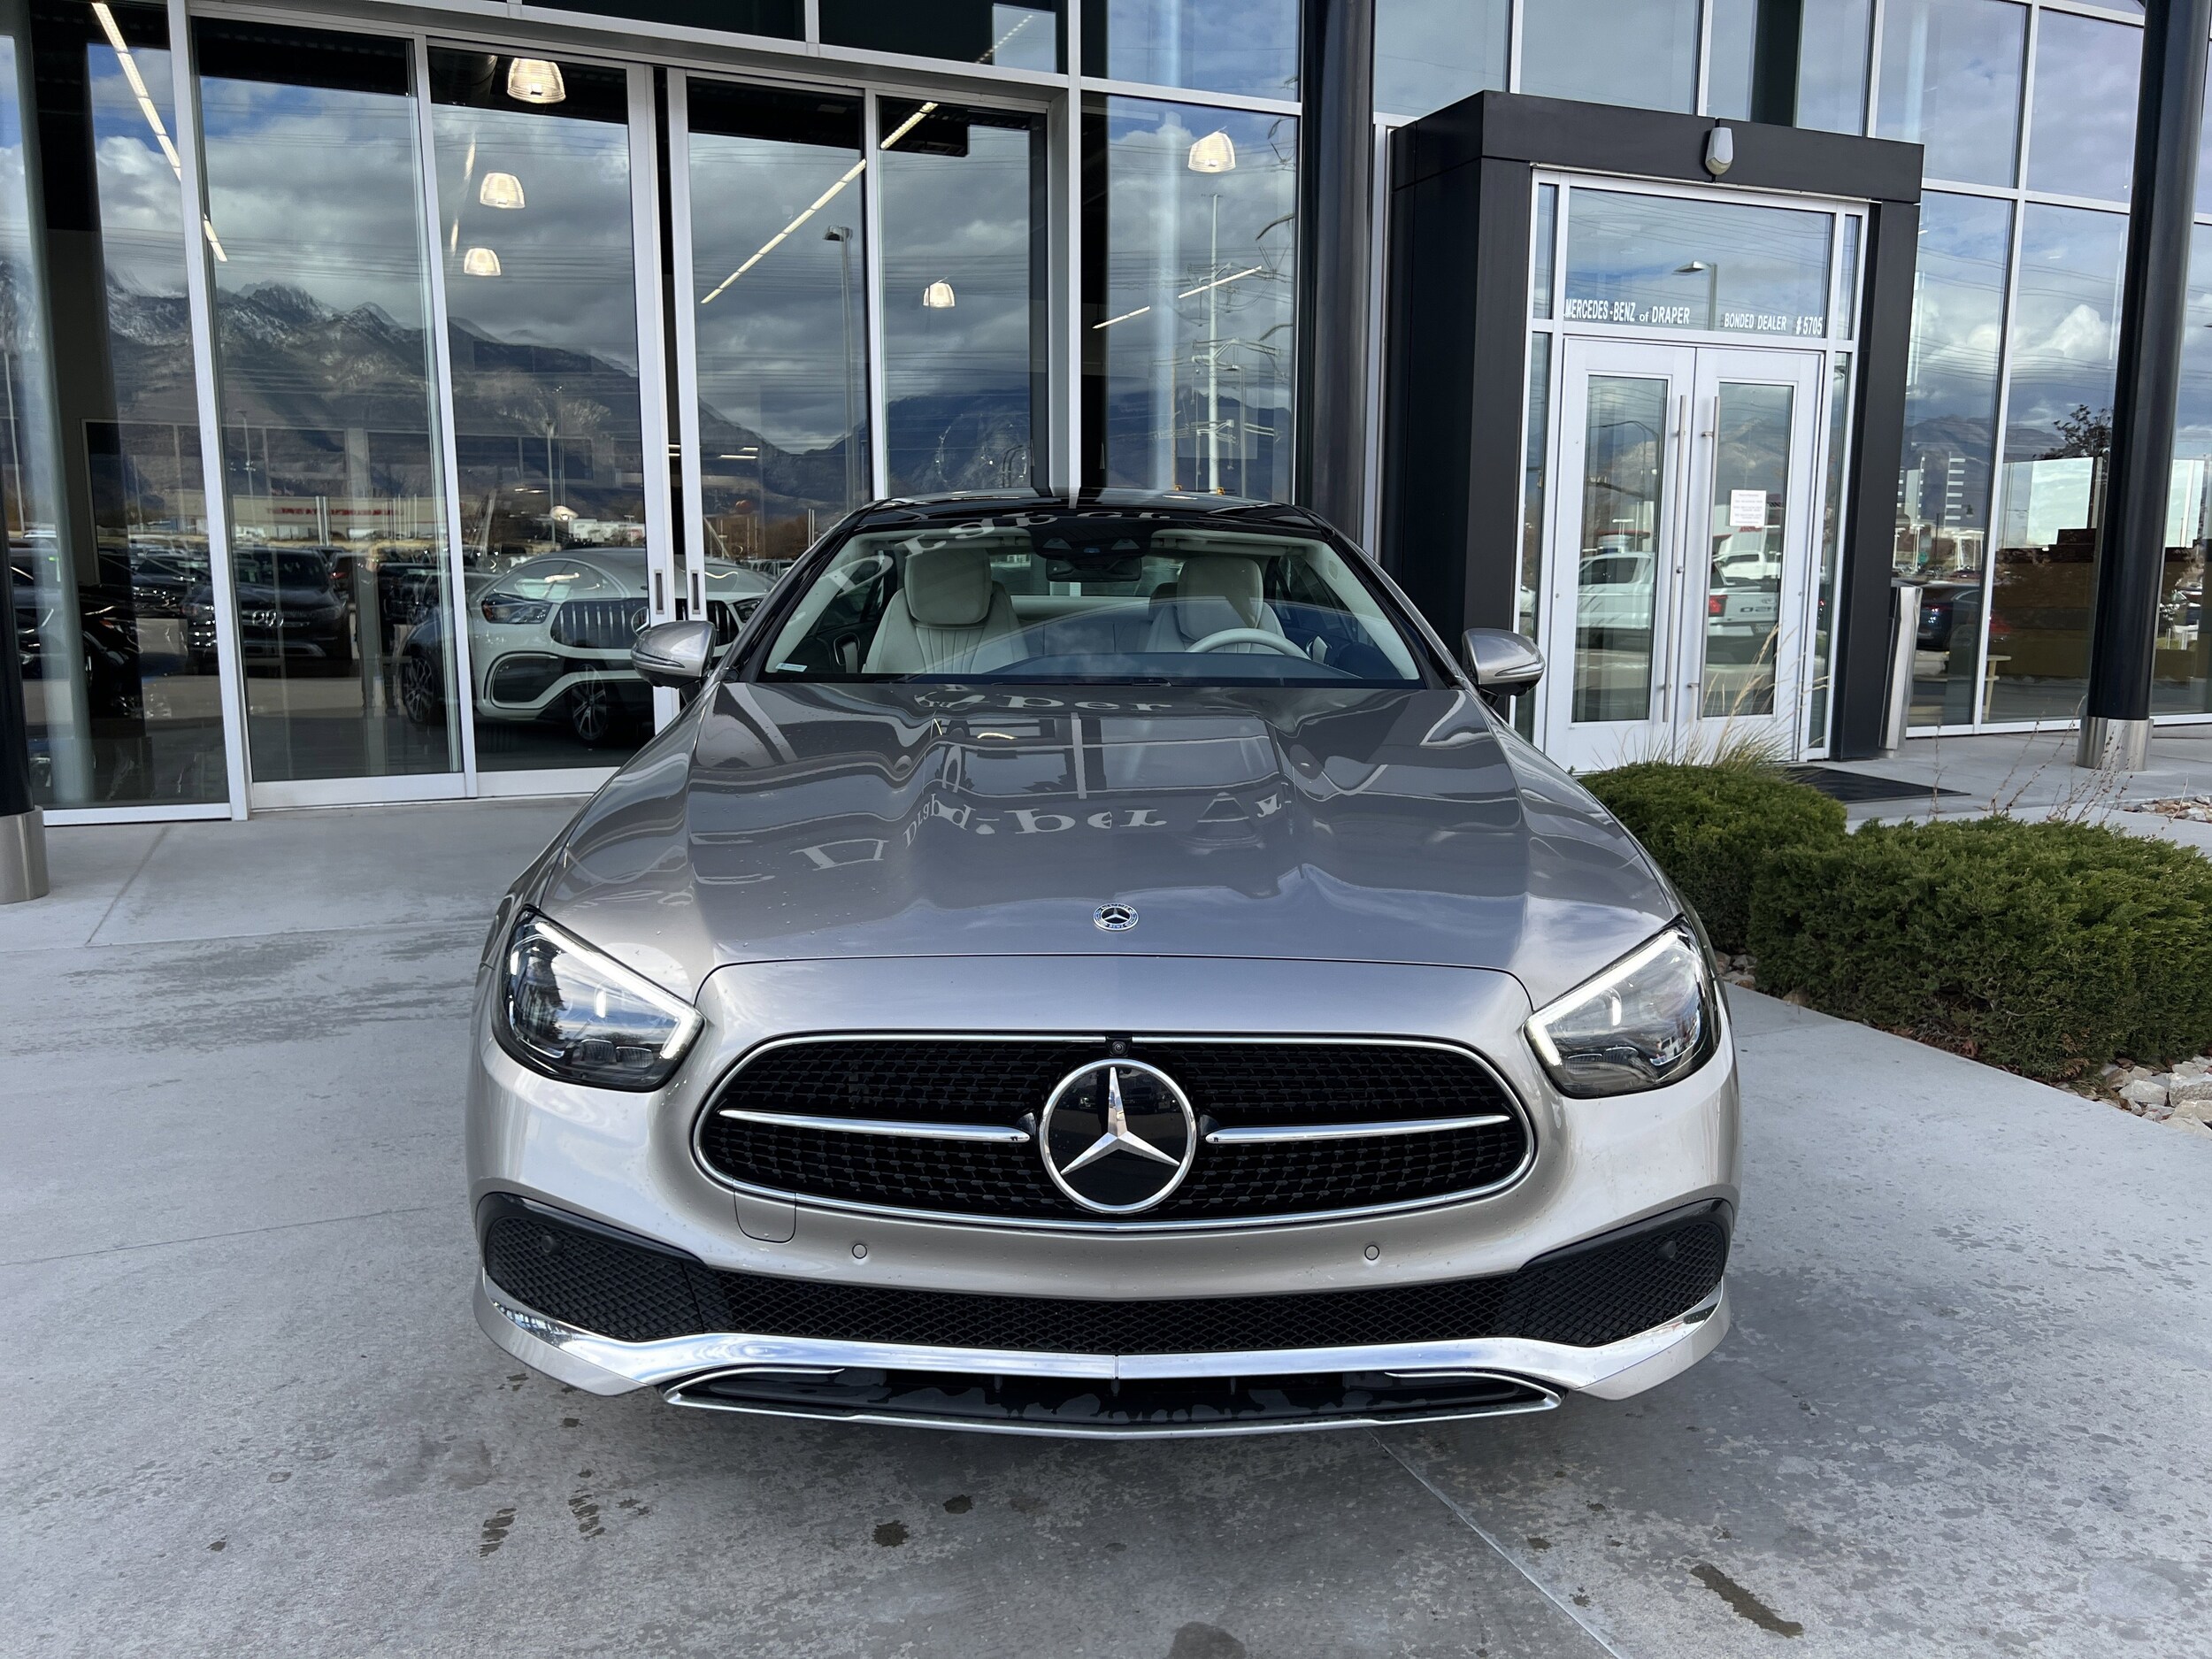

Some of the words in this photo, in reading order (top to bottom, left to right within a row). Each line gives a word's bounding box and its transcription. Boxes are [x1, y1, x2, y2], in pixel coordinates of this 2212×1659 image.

[1564, 298, 1636, 322] MERCEDES-BENZ
[1639, 311, 1649, 322] of
[1651, 305, 1690, 325] DRAPER
[1724, 312, 1754, 329] BONDED
[1756, 315, 1786, 332] DEALER
